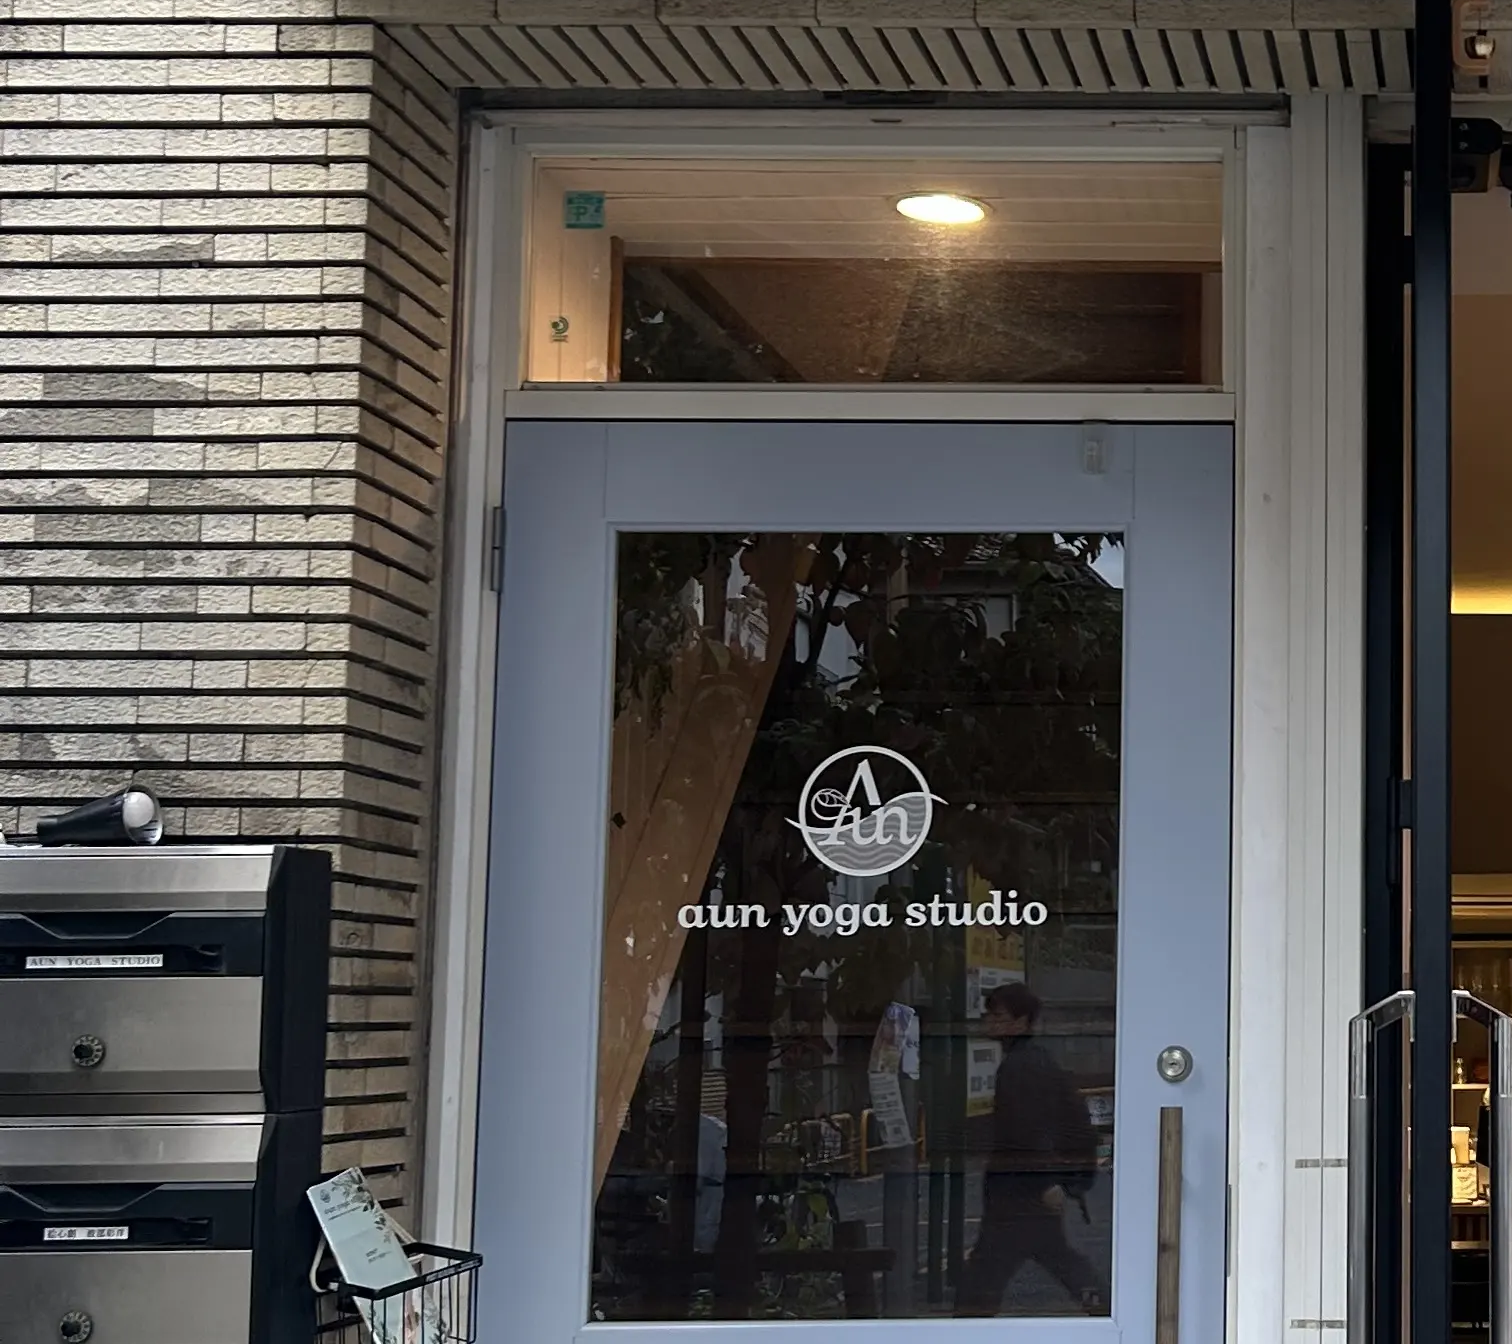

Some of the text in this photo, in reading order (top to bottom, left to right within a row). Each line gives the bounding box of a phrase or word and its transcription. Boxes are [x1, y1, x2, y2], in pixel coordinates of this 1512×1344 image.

[677, 889, 1048, 937] aun yoga studio
[29, 956, 161, 966] AUN YOGA STUDIO
